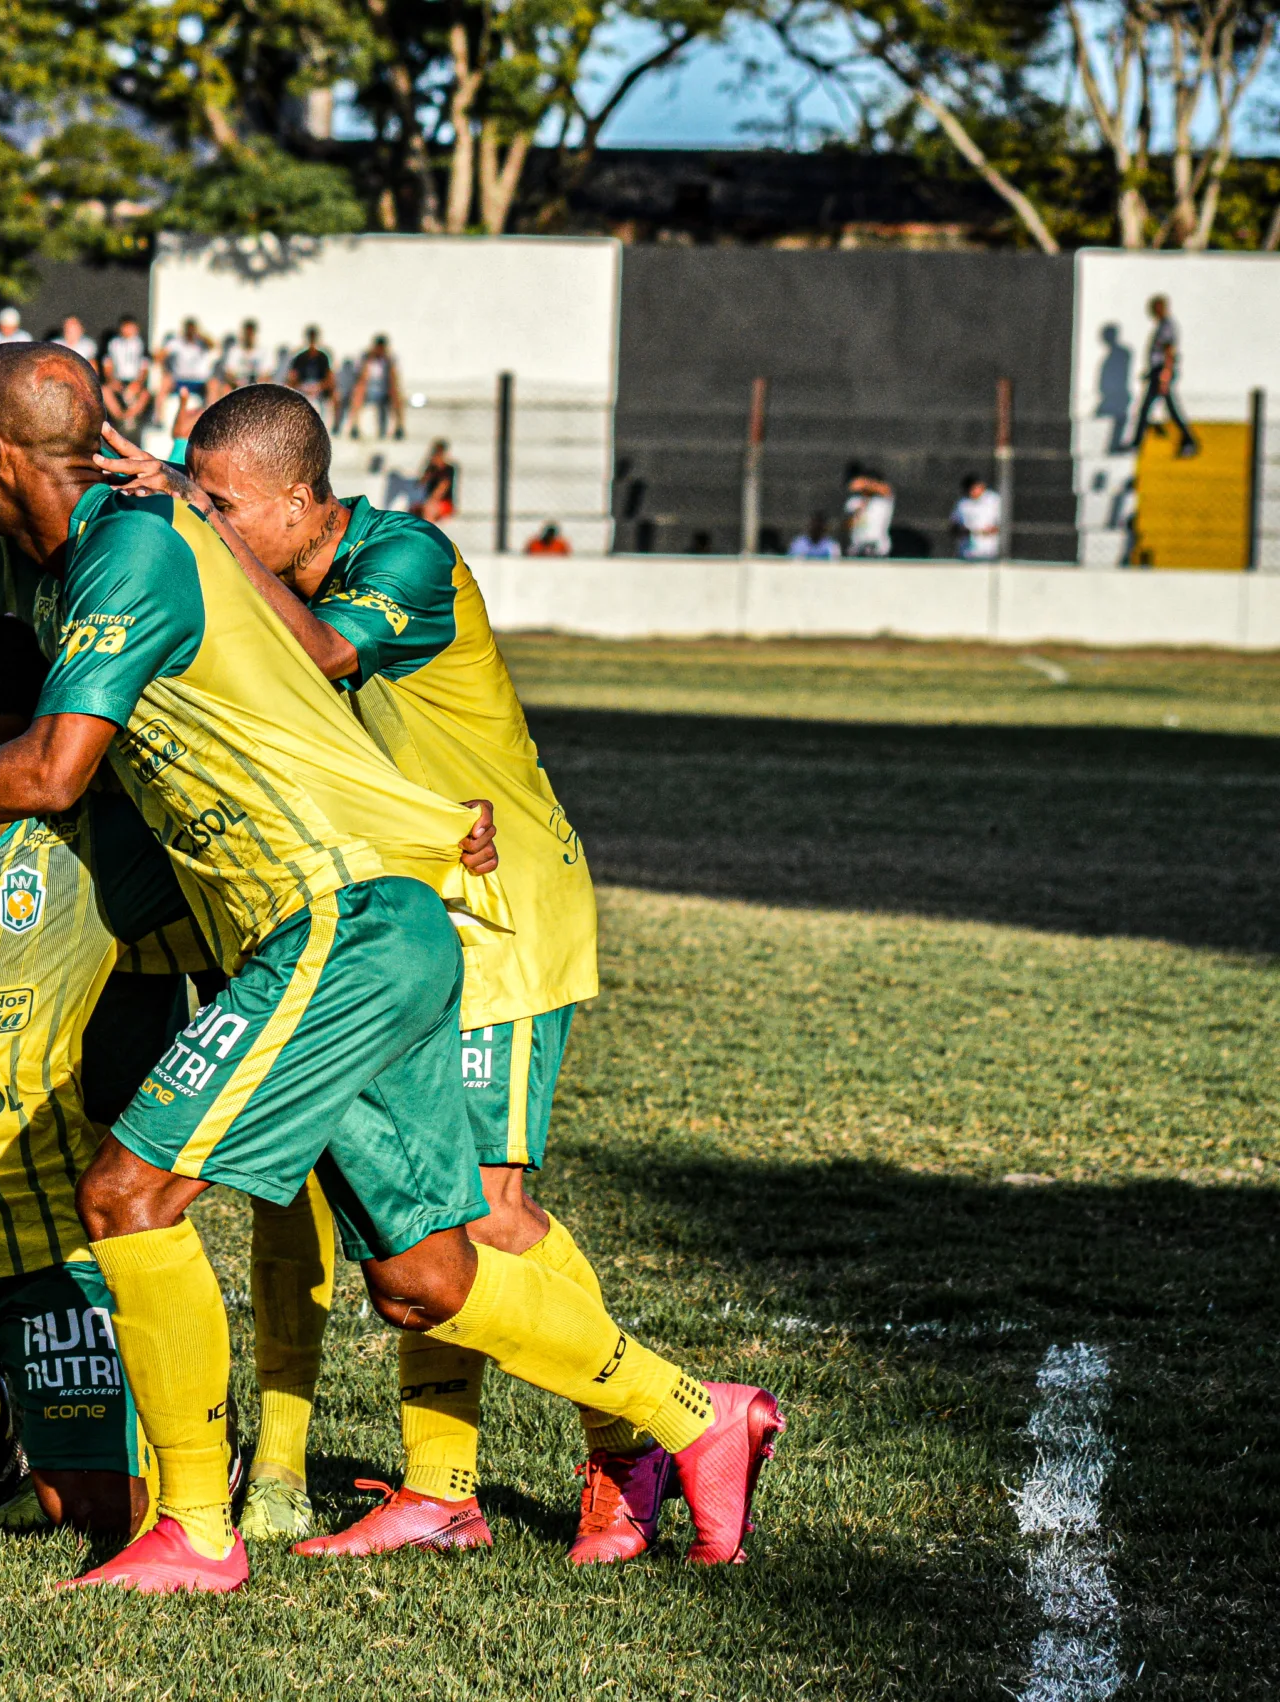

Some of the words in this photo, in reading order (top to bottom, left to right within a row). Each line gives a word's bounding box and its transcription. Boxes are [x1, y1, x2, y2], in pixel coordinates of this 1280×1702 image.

[10, 875, 34, 890] NV
[24, 1355, 122, 1392] NUTRI
[58, 1387, 122, 1397] RECOVERY
